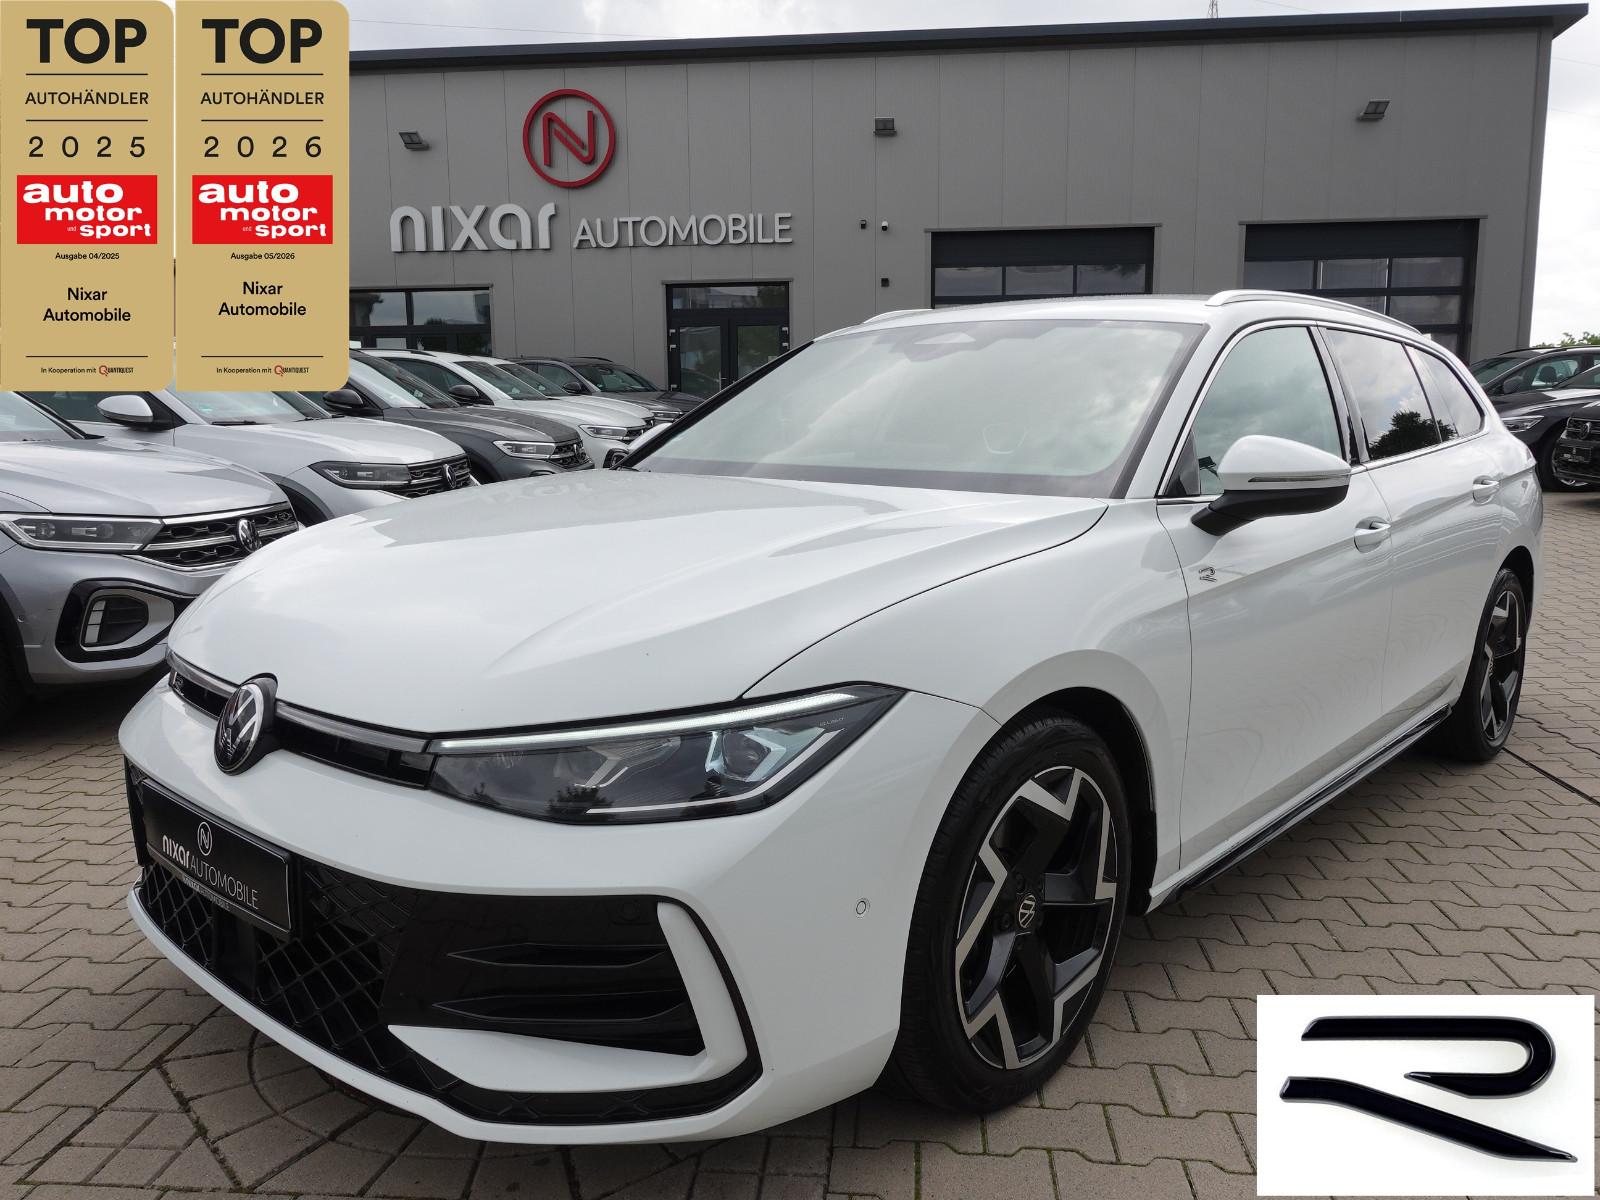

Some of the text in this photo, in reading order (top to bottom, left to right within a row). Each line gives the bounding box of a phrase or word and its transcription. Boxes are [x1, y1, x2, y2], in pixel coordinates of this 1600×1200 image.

[389, 202, 793, 252] nixar AUTOMOBILE
[162, 834, 190, 869] nixar
[190, 858, 260, 910] AUTOMOBILE
